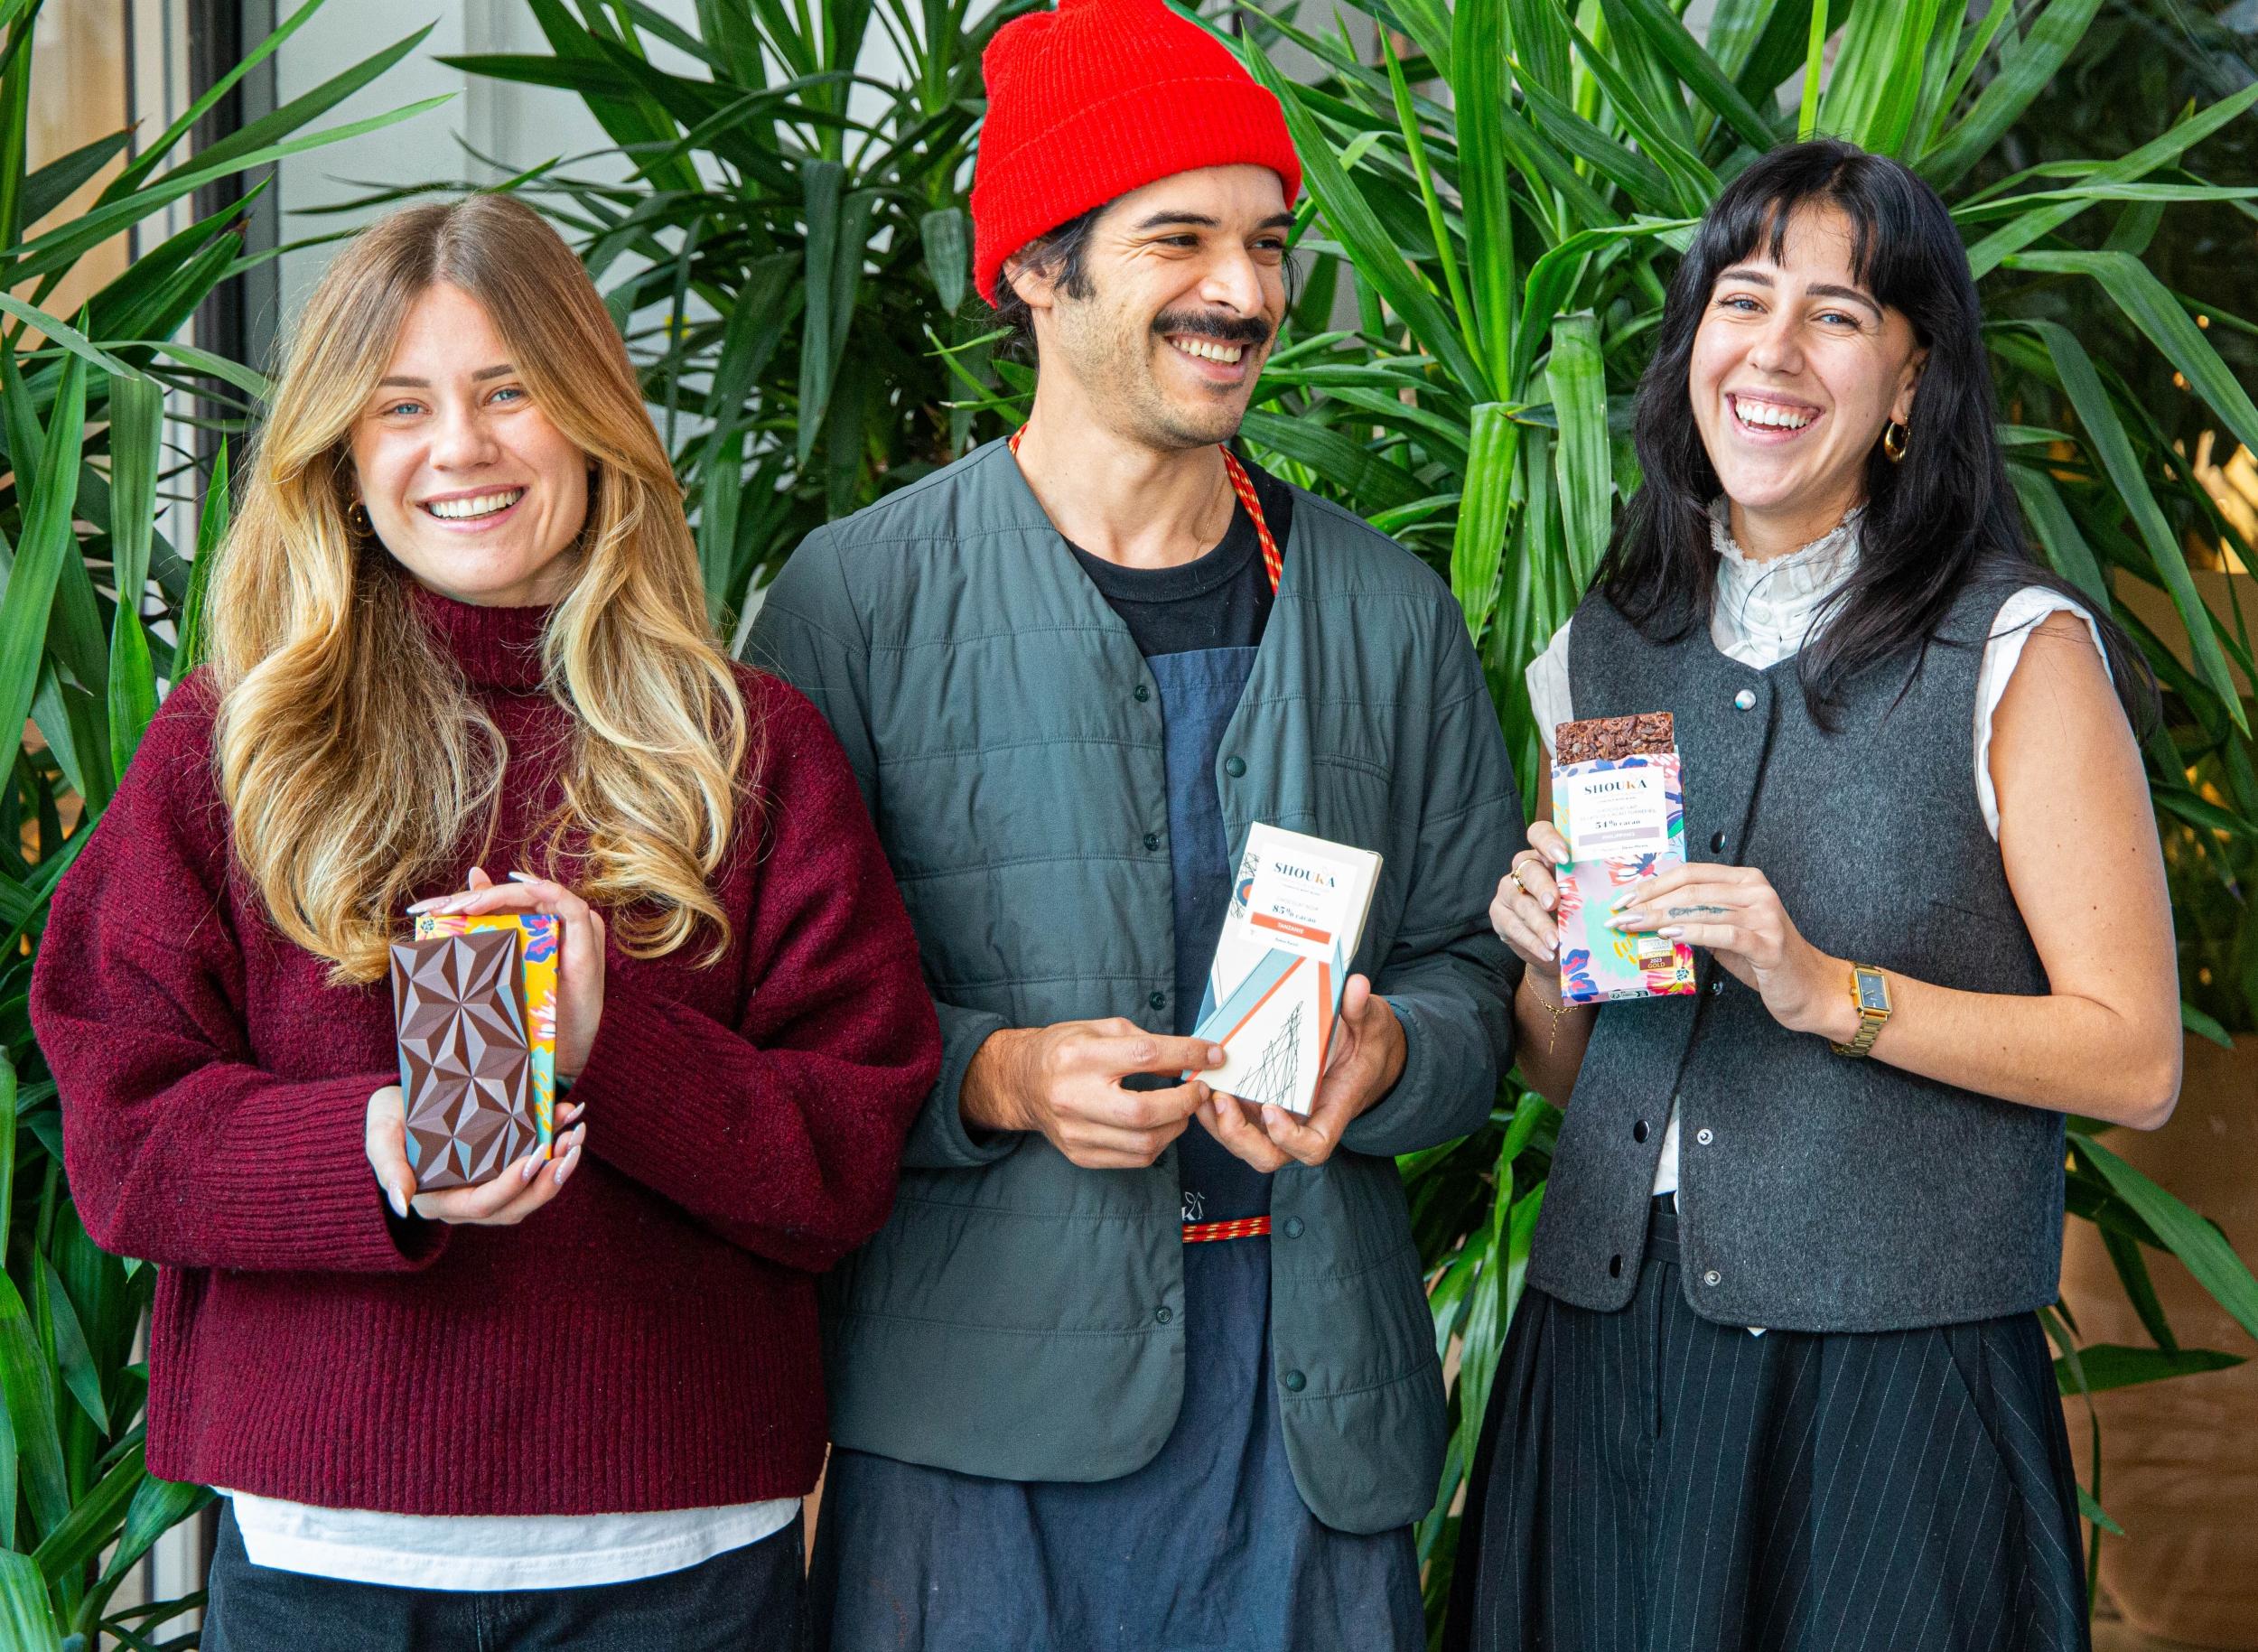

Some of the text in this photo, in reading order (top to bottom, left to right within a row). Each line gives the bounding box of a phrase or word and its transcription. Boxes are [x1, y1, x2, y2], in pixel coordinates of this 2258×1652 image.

[1584, 779, 1647, 795] SHOUKA
[1595, 820, 1617, 829] 54%
[1274, 862, 1336, 888] SHOUKA
[1272, 903, 1317, 923] 85% cacao
[1277, 922, 1304, 934] TANZANIE
